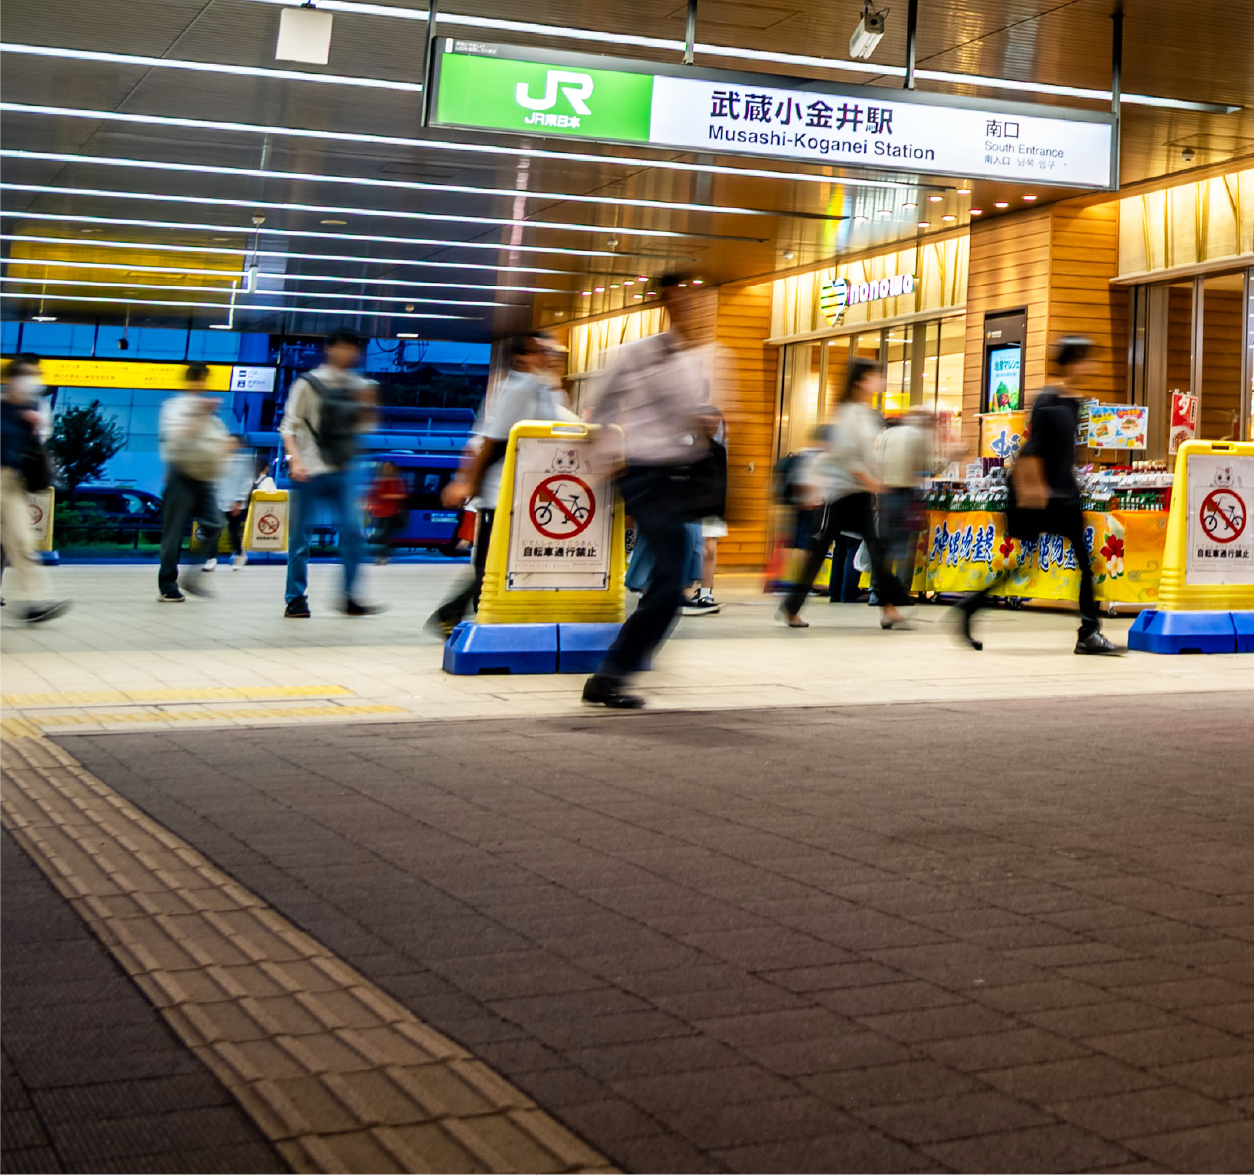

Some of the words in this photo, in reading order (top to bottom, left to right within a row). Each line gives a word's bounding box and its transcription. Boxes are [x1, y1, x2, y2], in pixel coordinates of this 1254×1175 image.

[515, 70, 594, 115] JR
[524, 112, 580, 128] JR東日本
[711, 90, 893, 135] 武蔵小金井駅
[985, 119, 1020, 139] 南口
[709, 124, 868, 154] Musashi-Koganei
[874, 140, 935, 160] Station
[985, 140, 1015, 154] South
[1018, 144, 1064, 159] Entrance
[848, 273, 914, 306] nonowa
[523, 546, 598, 558] 自転車通行禁止
[1197, 548, 1250, 559] 自転車通行禁止
